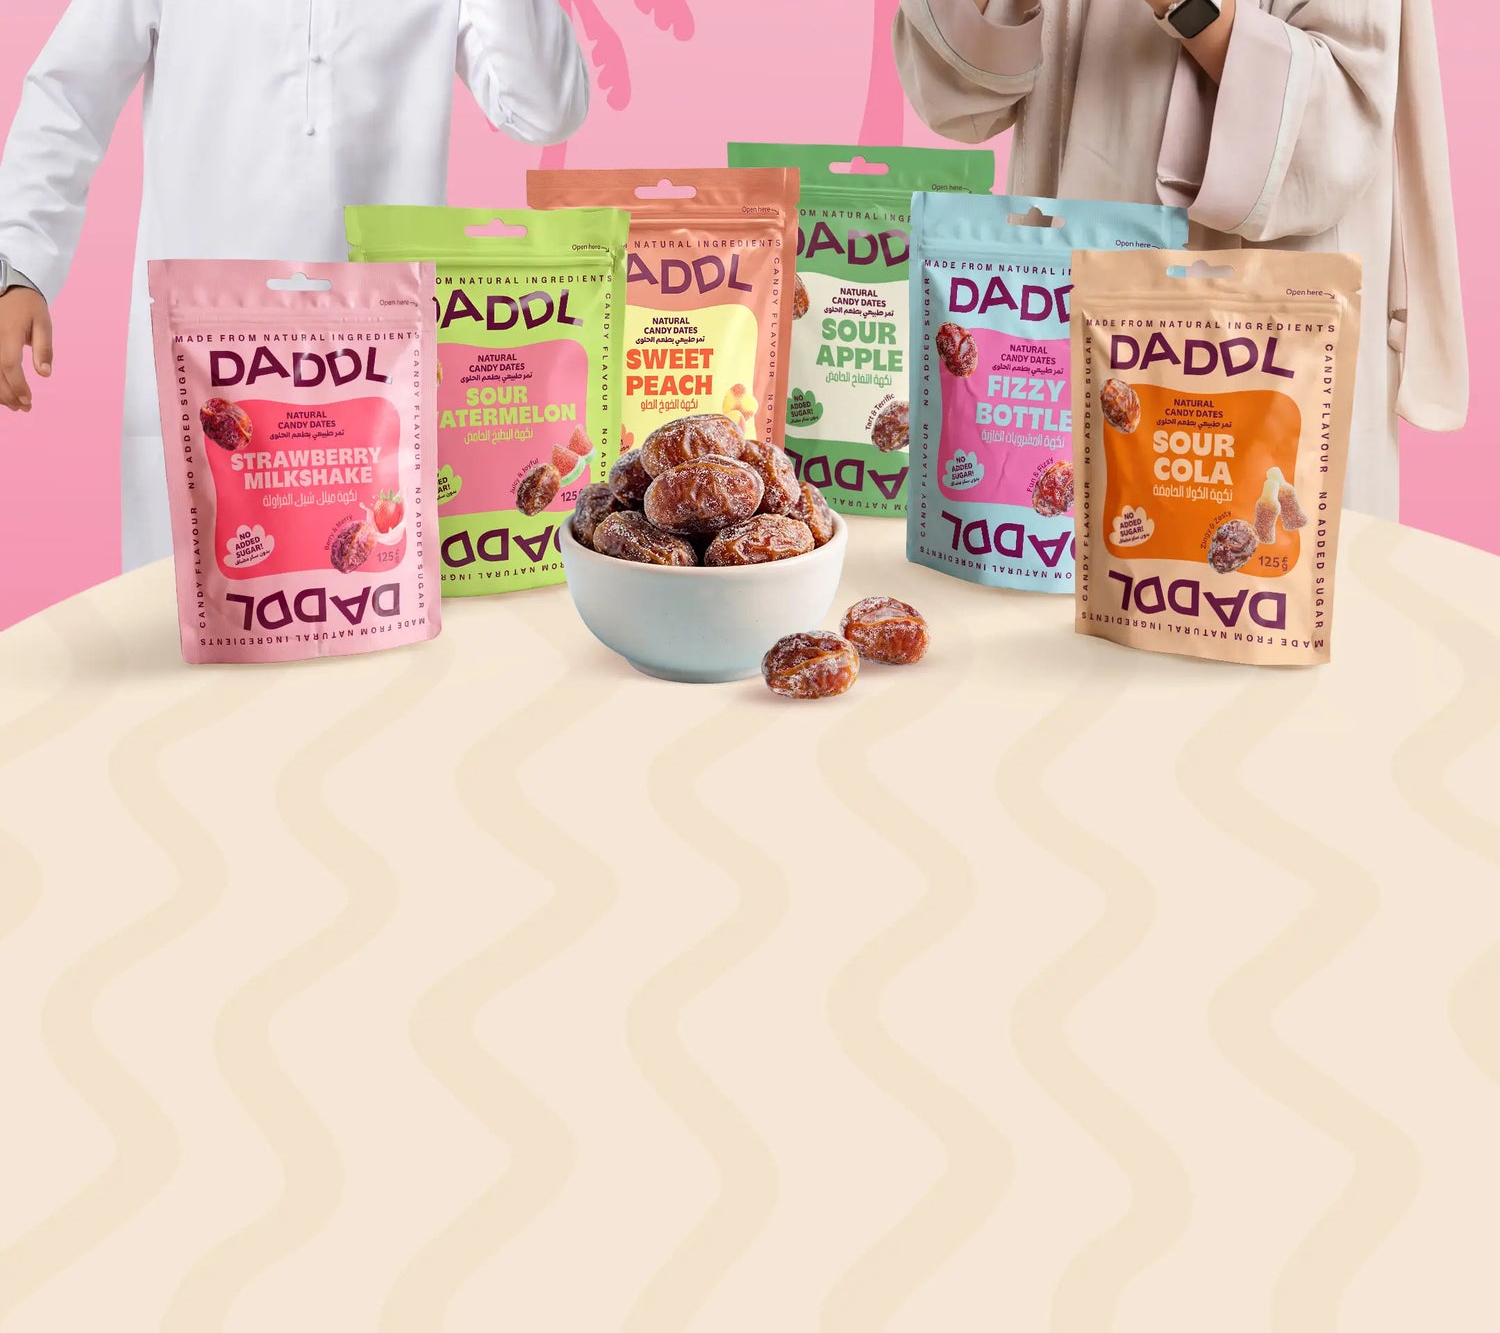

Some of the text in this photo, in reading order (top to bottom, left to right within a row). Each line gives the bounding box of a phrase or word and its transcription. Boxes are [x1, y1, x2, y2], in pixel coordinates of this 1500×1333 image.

[931, 184, 947, 192] Open
[741, 206, 757, 214] Open
[634, 240, 692, 249] NATURAL
[697, 239, 781, 248] INGREDIENTS
[626, 252, 753, 295] ADDL
[923, 259, 956, 269] MADE
[961, 261, 993, 272] FROM
[998, 263, 1055, 276] NATURAL
[435, 274, 612, 285] OM NATURAL INGREDIENTS
[771, 257, 780, 306] CANDY
[839, 287, 878, 298] NATURAL
[1285, 288, 1324, 298] Open here
[831, 296, 887, 308] CANDY DATES
[923, 278, 931, 326] SUGAR
[652, 317, 690, 325] NATURAL
[823, 306, 894, 319] تمر طبيعي بطعم الحلوى
[643, 326, 698, 335] CANDY DATES
[821, 317, 897, 345] SOUR
[1085, 318, 1336, 333] MADE FROM NATURAL INGREDIENTS
[175, 331, 420, 344] MADE FROM NATURAL INGREDIENTS
[635, 336, 705, 346] تمر طبيعي بطعم الحلوى
[769, 313, 778, 378] FLAVOUR
[477, 353, 517, 363] NATURAL
[1009, 344, 1048, 355] NATURAL
[1110, 331, 1295, 379] DADDL
[209, 346, 393, 387] DADDL
[625, 348, 714, 370] SWEET
[815, 344, 903, 373] APPLE
[1000, 353, 1056, 365] CANDY DATES
[469, 362, 525, 373] CANDY DATES
[991, 363, 1064, 376] تمر طبيعي بطعم الحلوى
[625, 375, 713, 396] PEACH
[987, 374, 1067, 403] FIZZY
[466, 385, 528, 406] SOUR
[767, 394, 774, 411] NO
[793, 394, 804, 402] NO
[923, 388, 929, 406] NO
[1173, 399, 1215, 408] NATURAL
[640, 399, 699, 413] نكهة الخوخ الحلو
[790, 401, 811, 410] ADDED
[865, 415, 874, 430] Tart
[875, 393, 895, 410] Terrific
[1165, 408, 1224, 419] CANDY DATES
[286, 411, 327, 420] NATURAL
[436, 403, 577, 428] ATERMELON
[975, 401, 1072, 433] BOTTLE
[277, 420, 336, 430] CANDY DATES
[413, 405, 421, 470] FLAVOUR
[601, 428, 608, 445] NO
[1153, 429, 1235, 458] SOUR
[230, 447, 383, 471] STRAWBERRY
[921, 423, 929, 487] FLAVOUR
[955, 456, 966, 464] NO
[1085, 445, 1091, 465] NO
[784, 447, 909, 500] ADDL
[951, 462, 973, 473] ADDED
[1026, 477, 1036, 493] Fun
[1037, 456, 1054, 473] Fizzy
[1153, 457, 1234, 486] COLA
[244, 466, 373, 490] MILKSHAKE
[1315, 343, 1334, 629] CANDY FLAVOUR NO ADDED SUGAR
[176, 353, 206, 629] CANDY FLAVOUR NO ADDED SUGAR
[415, 487, 421, 505] NO
[560, 490, 577, 502] 125
[1152, 484, 1233, 505] نكهة الكولا الحامضة
[833, 497, 888, 510] NATURAL
[1119, 518, 1142, 530] ADDED
[1124, 512, 1134, 520] NO
[239, 531, 251, 541] NO
[1119, 526, 1145, 537] SUGAR!
[235, 536, 261, 551] ADDED
[235, 543, 264, 559] SUGAR!
[440, 524, 562, 568] ADD
[1258, 555, 1288, 572] 125 g
[1082, 553, 1090, 602] CANDY
[226, 583, 401, 631] DADDL
[1108, 569, 1287, 630] DADDL
[200, 618, 425, 646] MADE FROM NATURAL INGREDIENTS
[1081, 611, 1324, 649] MADE FROM NATURAL INGREDIENTS
